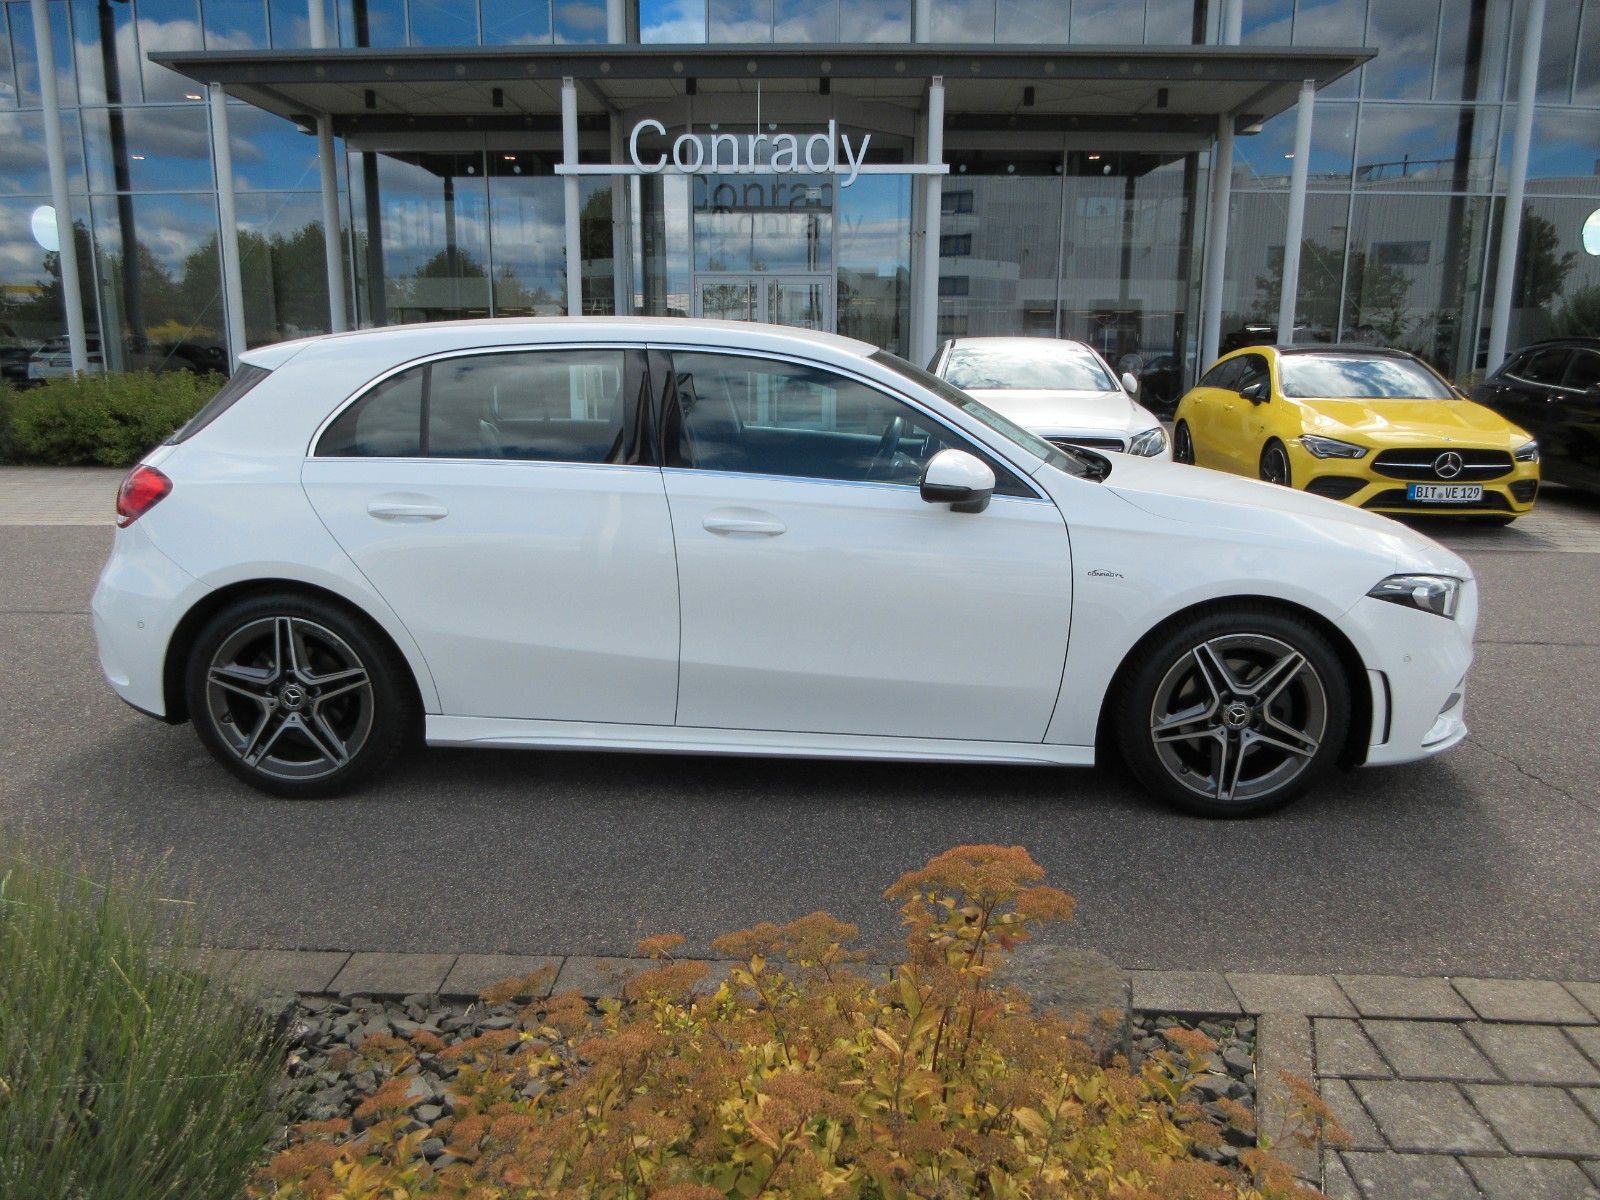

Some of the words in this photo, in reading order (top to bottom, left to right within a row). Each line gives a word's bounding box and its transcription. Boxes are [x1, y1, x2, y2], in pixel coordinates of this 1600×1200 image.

[630, 119, 872, 187] Conrady
[1416, 486, 1437, 498] BIT
[1445, 487, 1459, 498] VE
[1460, 487, 1480, 498] 129
